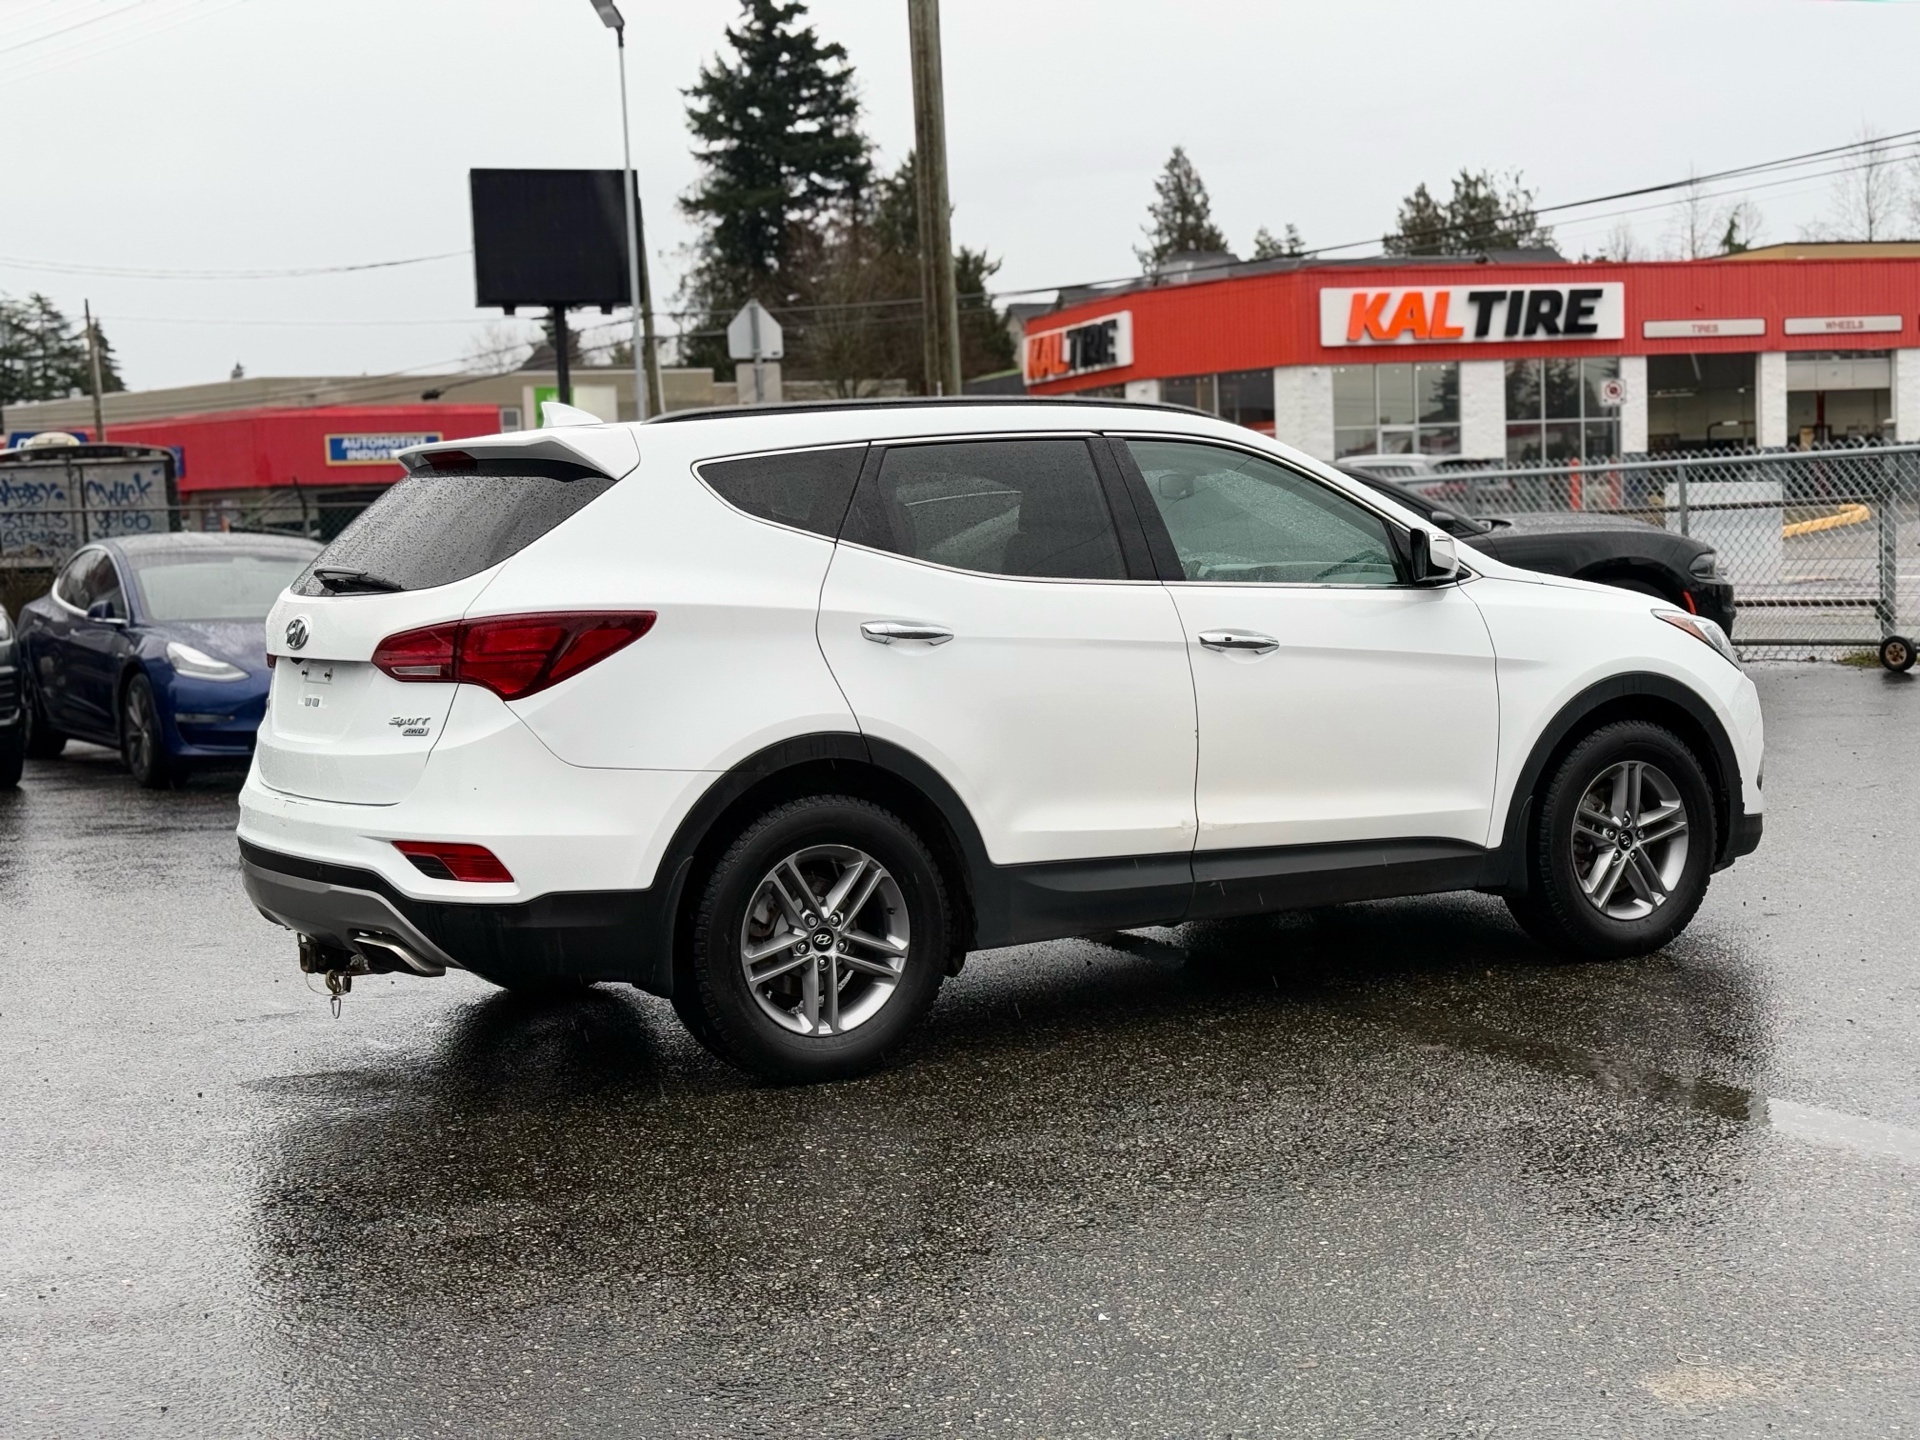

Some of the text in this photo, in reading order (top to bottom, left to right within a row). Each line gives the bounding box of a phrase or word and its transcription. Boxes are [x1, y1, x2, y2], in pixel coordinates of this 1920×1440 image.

[1347, 289, 1603, 341] KAL TIRE
[1691, 323, 1719, 334] TIRES
[1825, 320, 1864, 330] WHEELS
[1028, 319, 1117, 379] KAL TIRE
